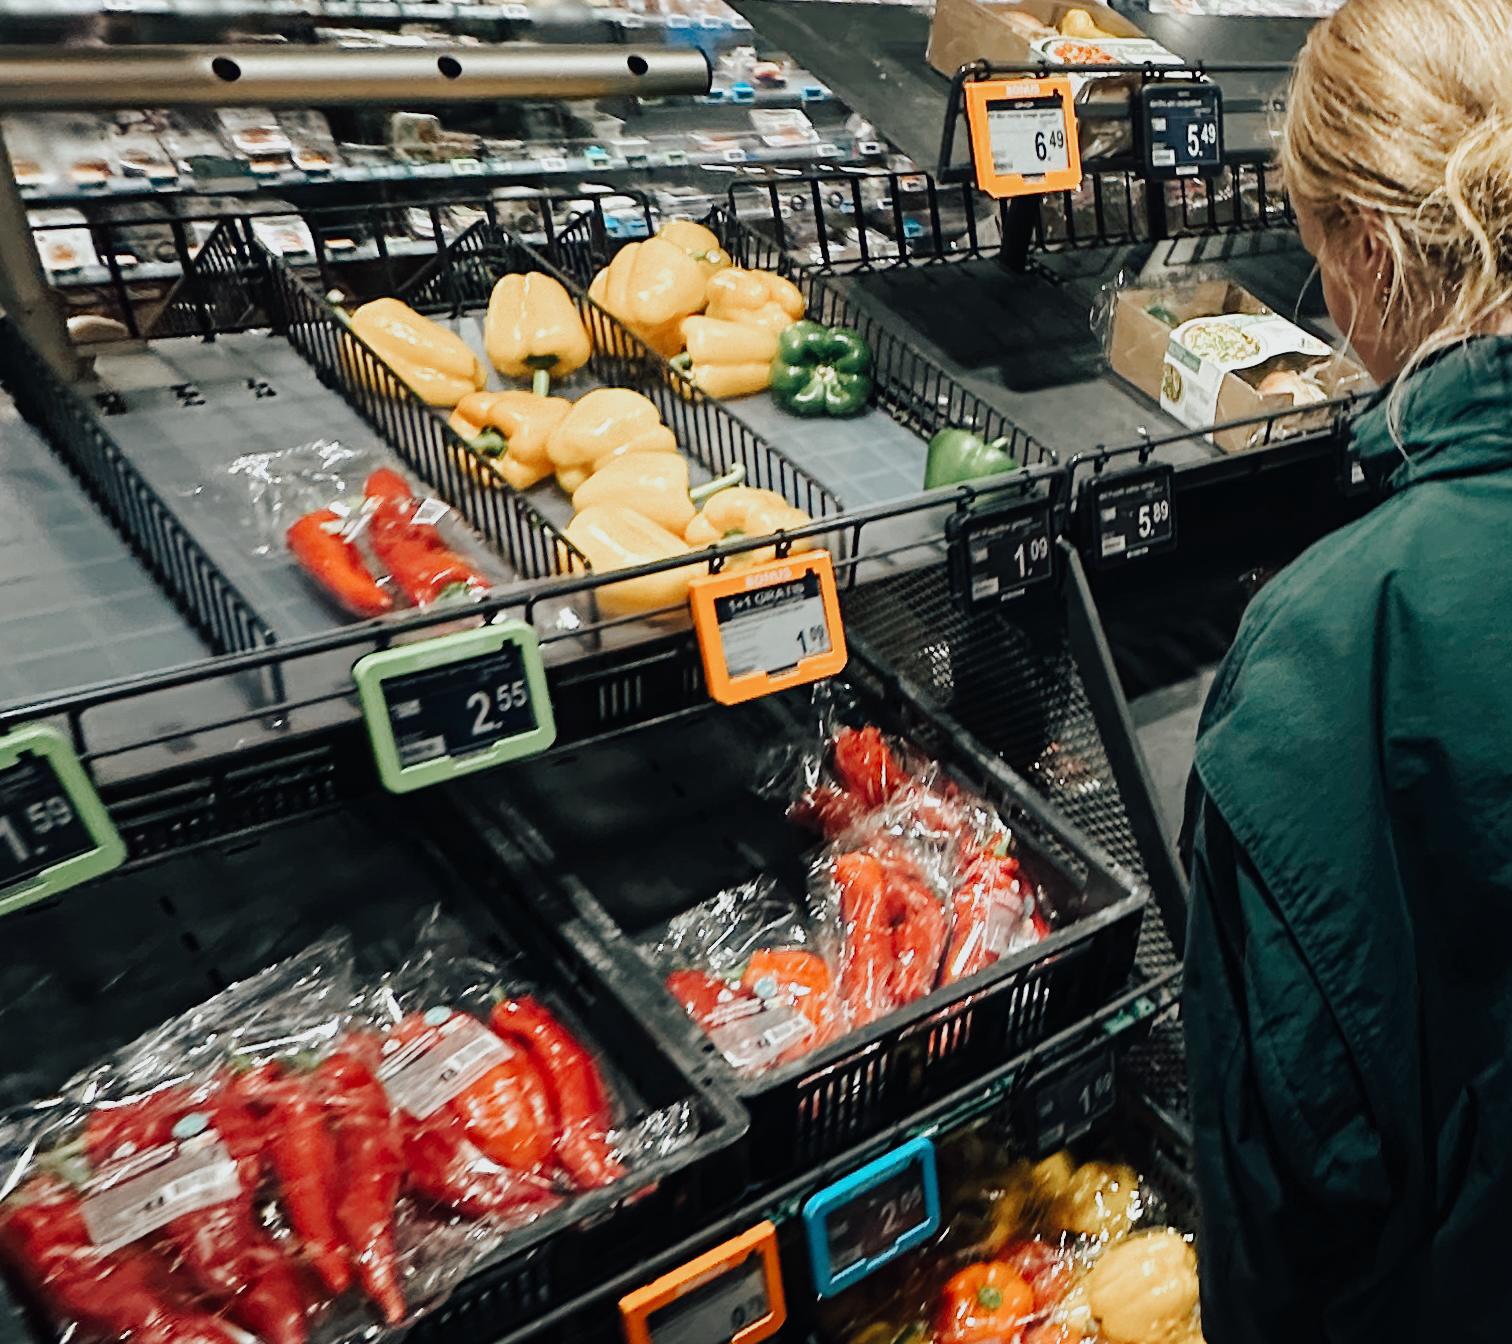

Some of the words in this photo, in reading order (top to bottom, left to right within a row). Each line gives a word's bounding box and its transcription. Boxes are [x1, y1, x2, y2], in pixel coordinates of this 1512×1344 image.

[1035, 129, 1064, 161] 6.49
[1187, 122, 1216, 157] 5.49
[1139, 500, 1169, 538] 5.89
[1014, 536, 1048, 578] 1.09
[466, 679, 528, 737] 2.55
